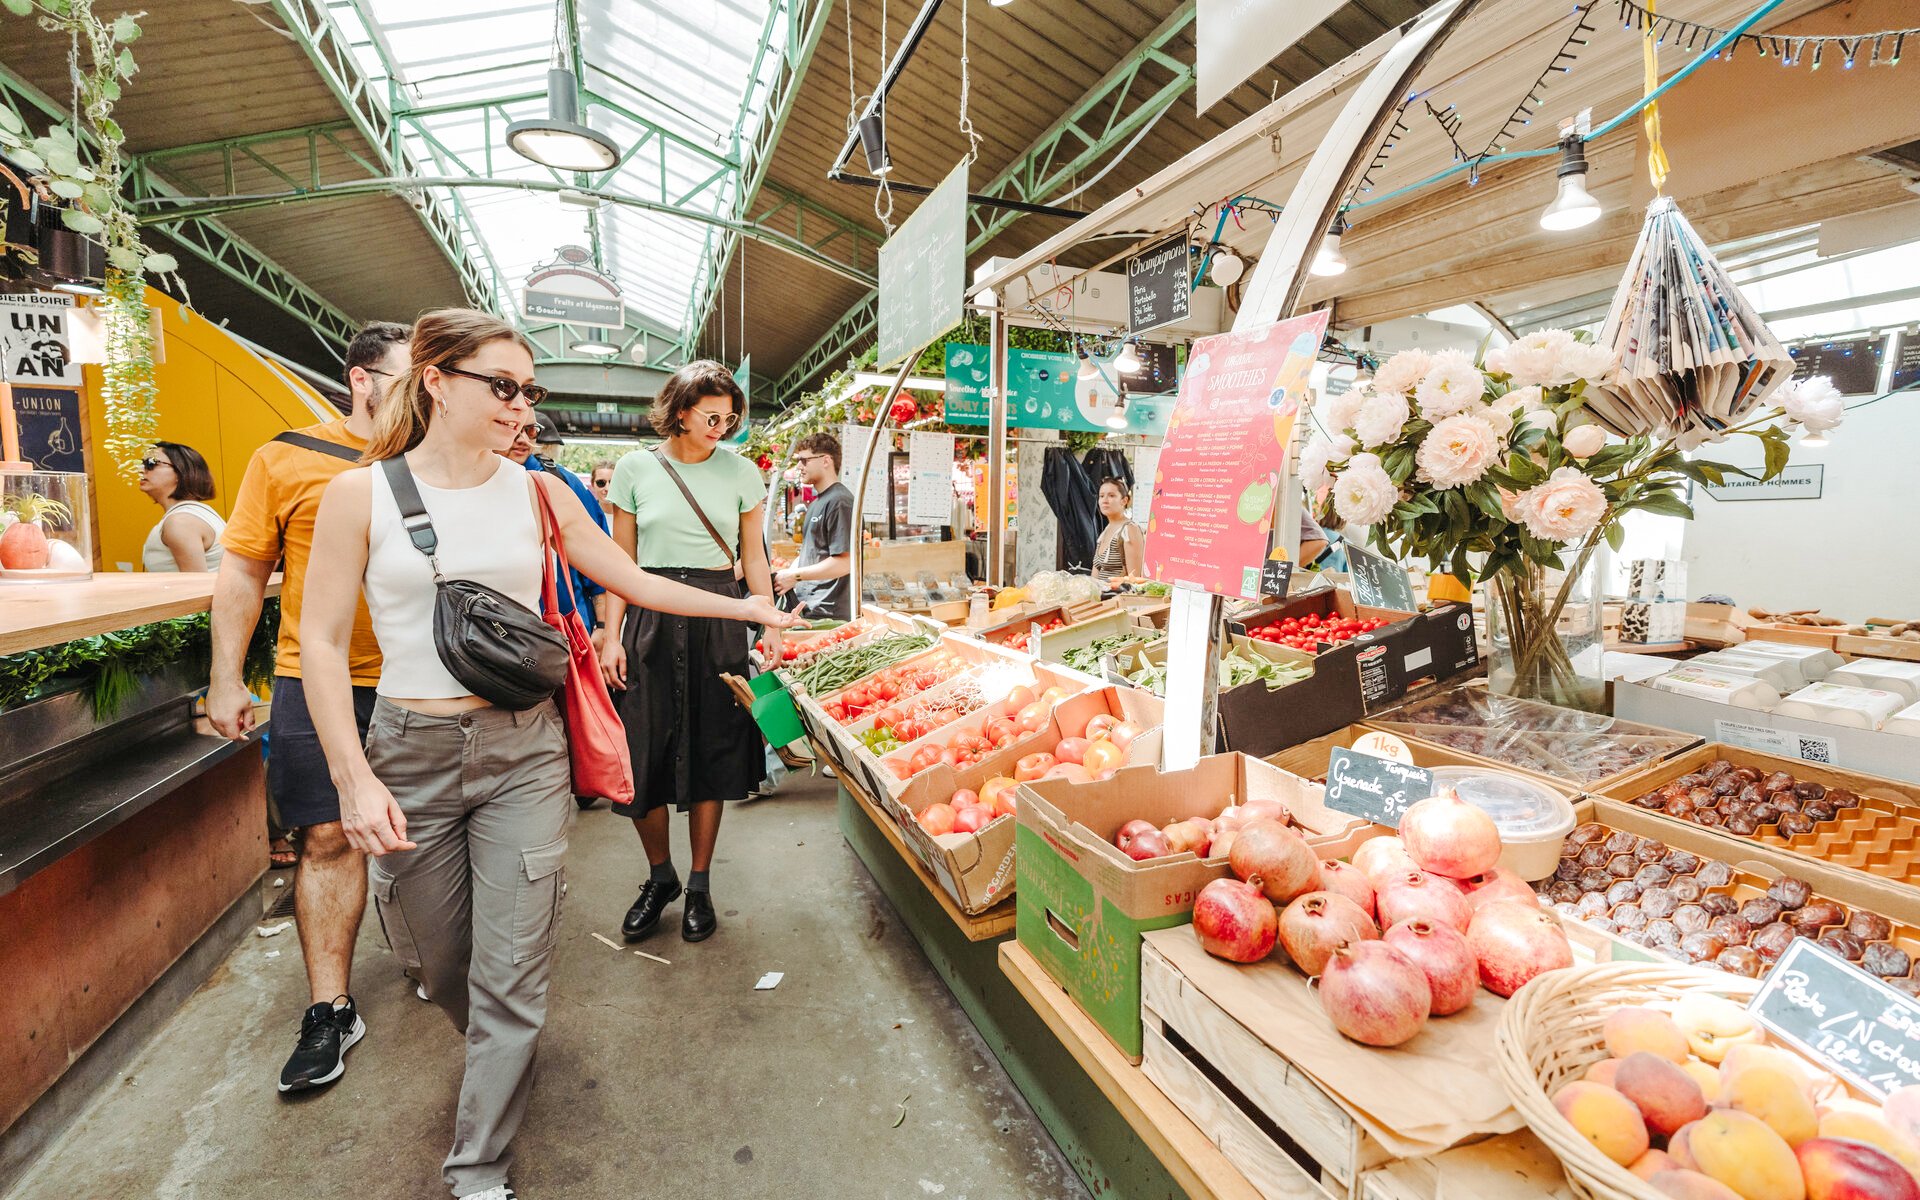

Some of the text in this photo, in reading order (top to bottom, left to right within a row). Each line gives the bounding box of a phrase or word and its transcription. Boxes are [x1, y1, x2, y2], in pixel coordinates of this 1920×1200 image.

[1130, 242, 1186, 277] Champignons
[1133, 285, 1146, 296] Paris
[30, 295, 71, 306] BOIRE
[553, 297, 575, 307] Fruits
[576, 299, 584, 307] et
[535, 305, 567, 316] Boucher
[11, 312, 62, 334] UN
[16, 353, 64, 377] AN
[1207, 367, 1268, 392] SMOOTHIES
[949, 383, 977, 394] Smoothie
[949, 400, 979, 413] ONLY
[1767, 478, 1812, 487] HOMMES
[1355, 563, 1374, 606] Herbes
[1373, 736, 1400, 758] 1kg
[1329, 757, 1384, 799] Grenade
